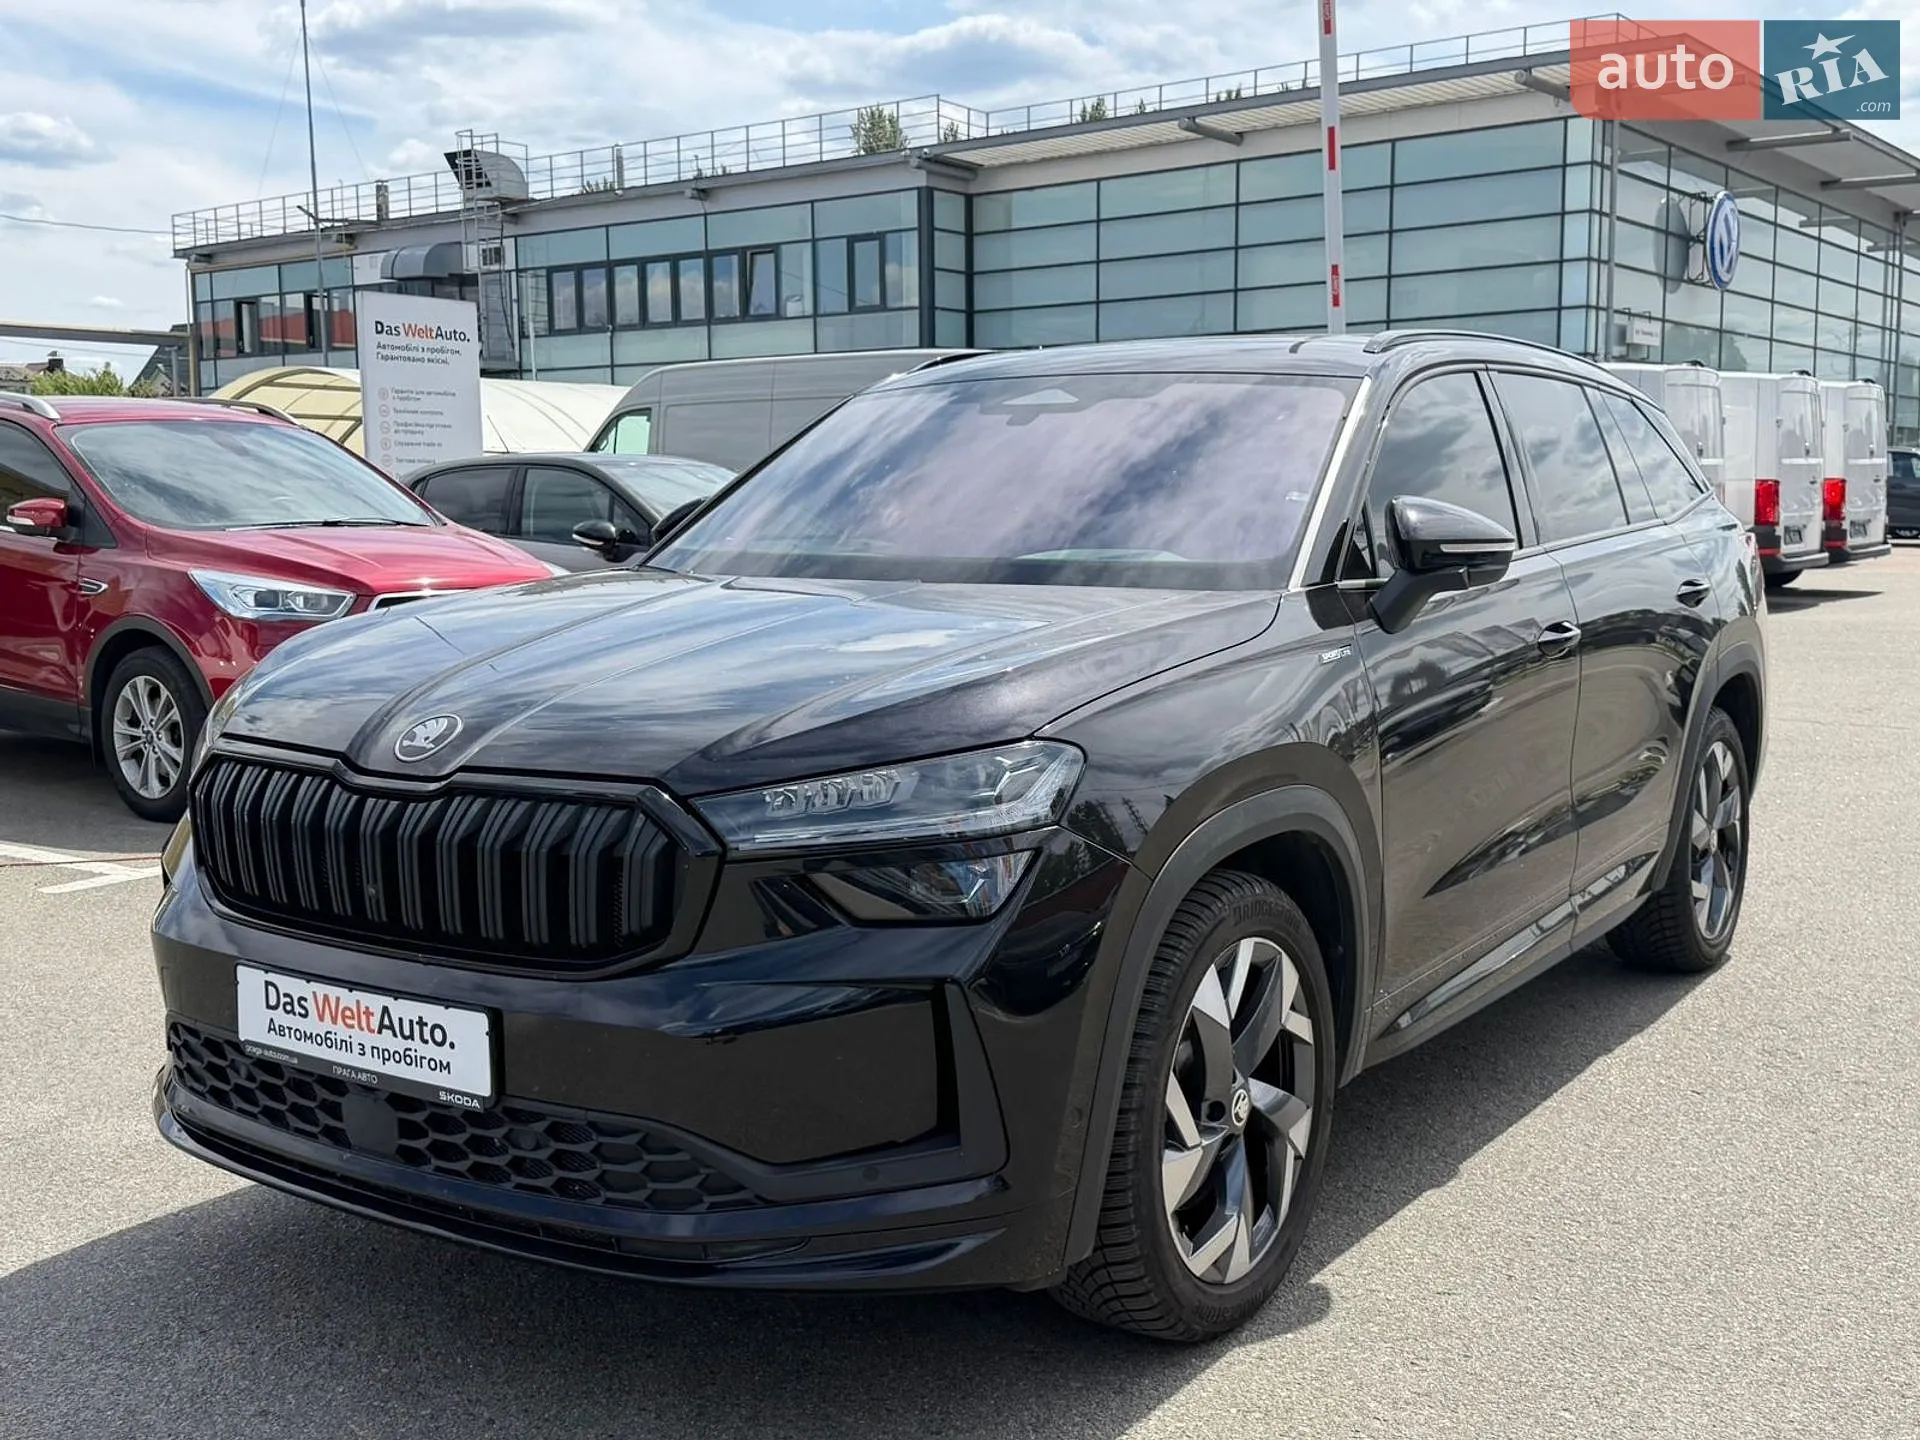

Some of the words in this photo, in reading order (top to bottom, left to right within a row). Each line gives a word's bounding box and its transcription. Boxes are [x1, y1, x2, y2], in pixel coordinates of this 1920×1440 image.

[375, 320, 401, 337] Das
[264, 980, 310, 1019] Das
[267, 1017, 353, 1054] Автомобілі
[357, 1042, 366, 1056] з
[371, 1045, 451, 1075] пробігом
